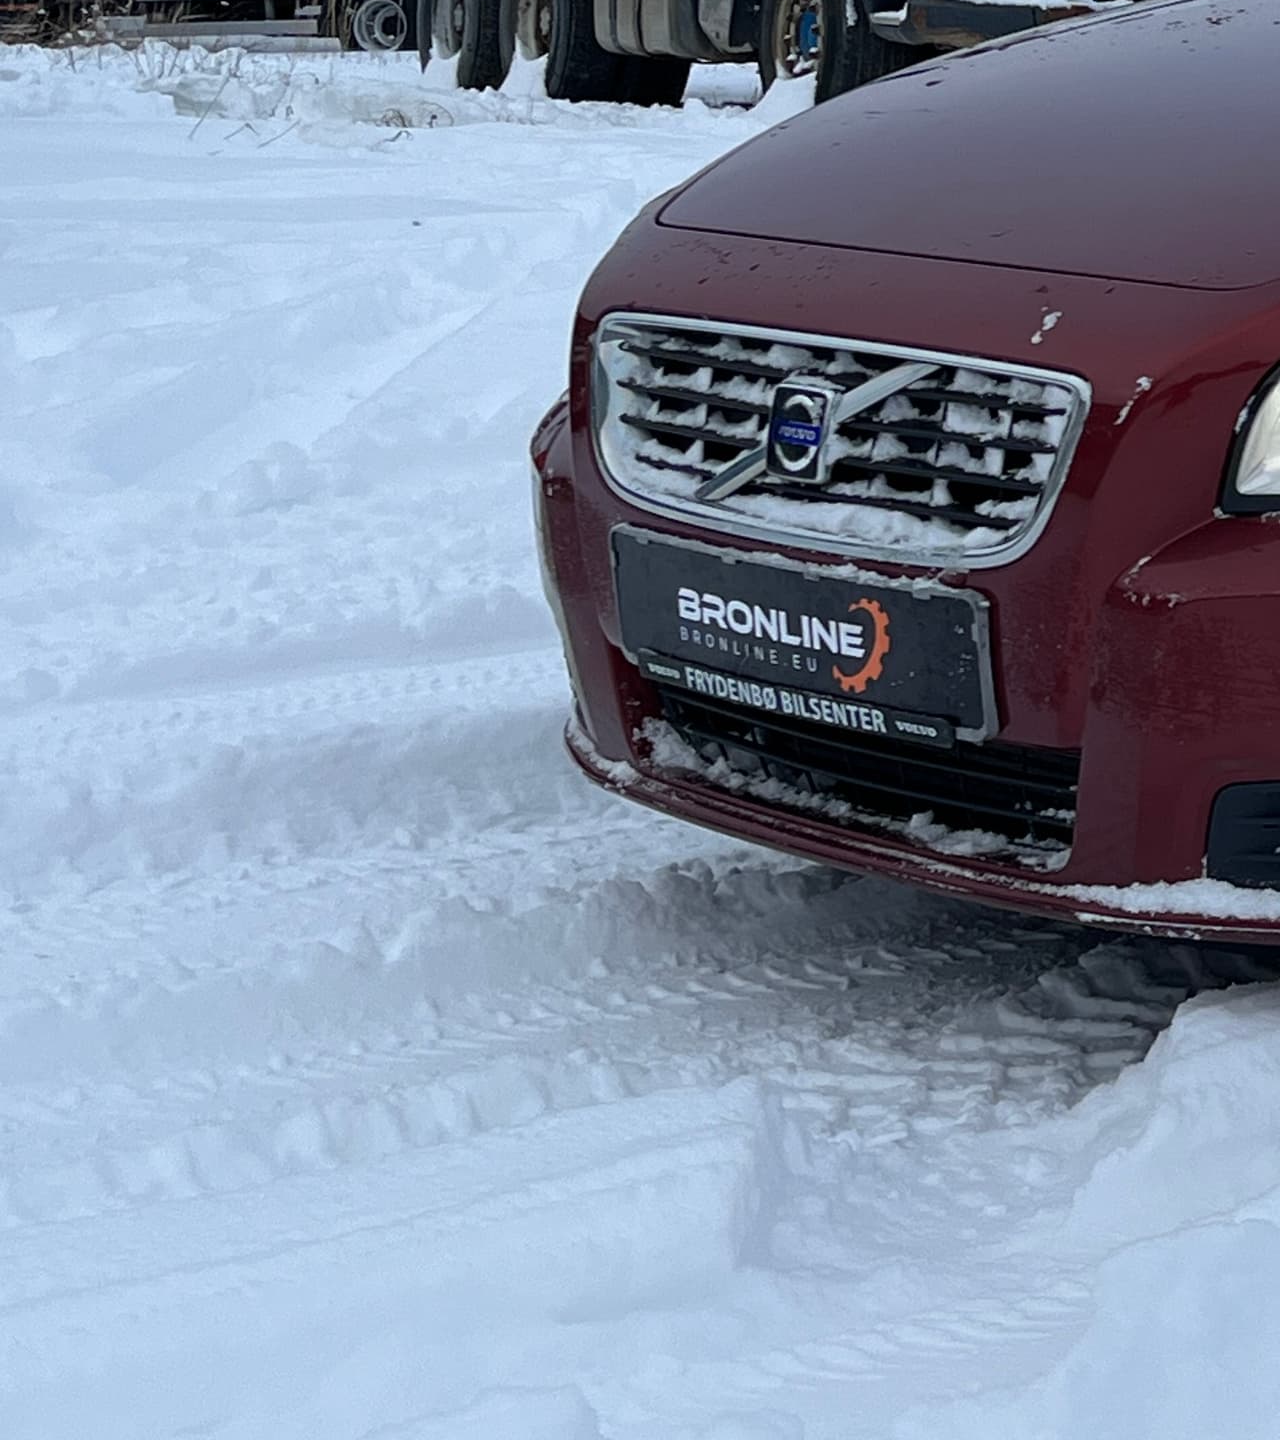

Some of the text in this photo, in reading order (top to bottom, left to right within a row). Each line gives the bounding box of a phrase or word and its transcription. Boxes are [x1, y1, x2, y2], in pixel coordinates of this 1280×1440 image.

[677, 587, 866, 658] BRONLINE
[679, 625, 818, 673] BRONLINE.EU
[684, 666, 777, 710] FRYDENBØ
[780, 690, 887, 733] BILSENTER
